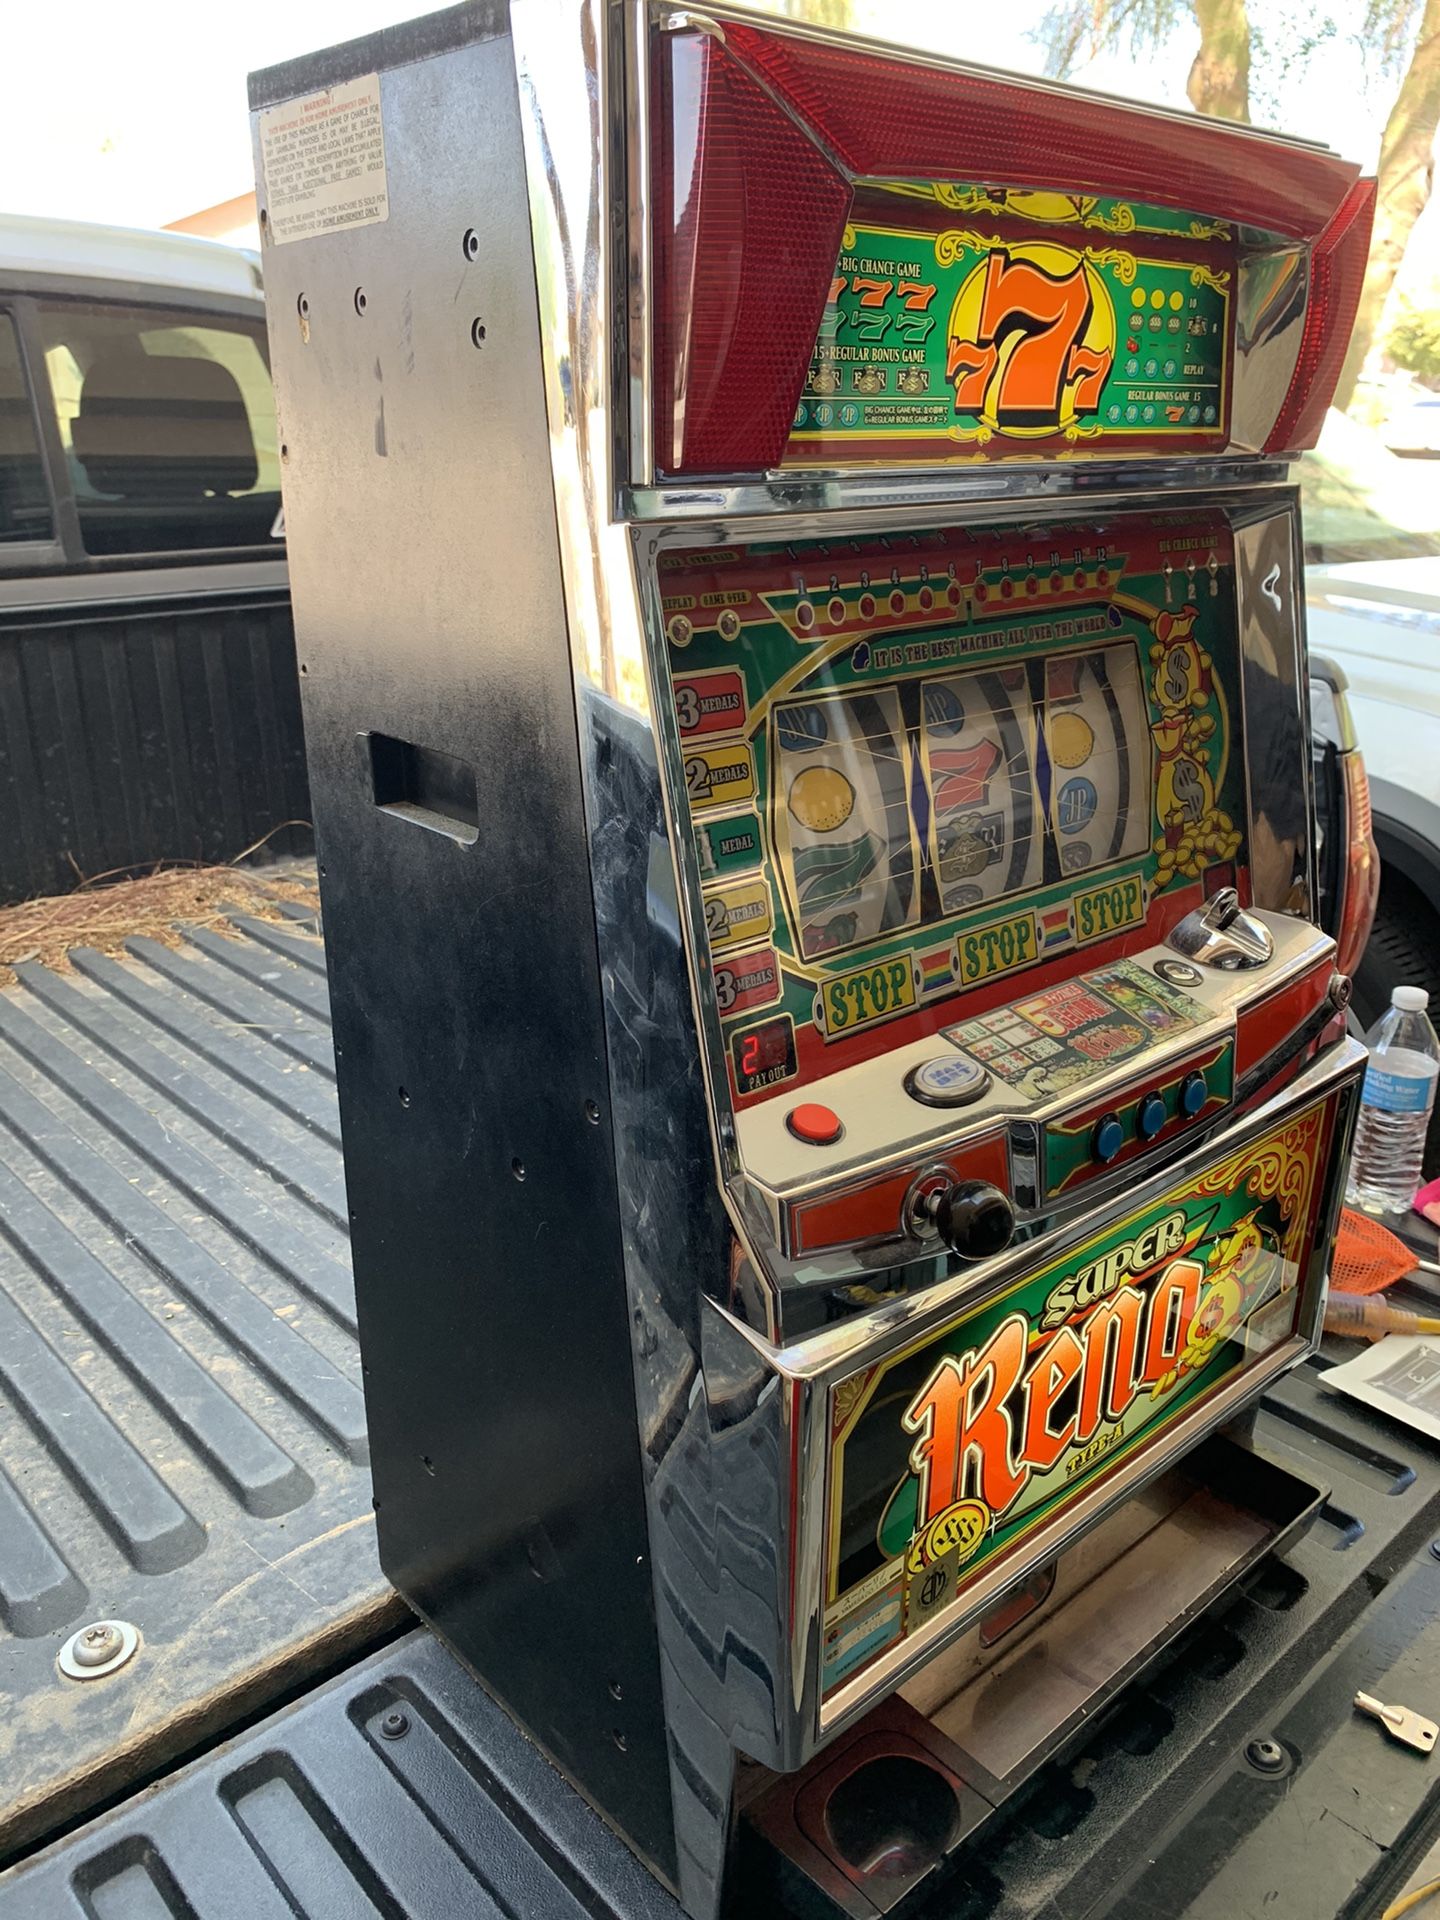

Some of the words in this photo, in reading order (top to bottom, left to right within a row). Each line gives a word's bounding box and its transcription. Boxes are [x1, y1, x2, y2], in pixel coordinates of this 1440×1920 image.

[288, 129, 298, 140] THIS
[299, 123, 317, 136] MACHINE
[330, 115, 342, 127] GAME
[350, 107, 368, 120] CHANCE
[369, 103, 378, 114] FOR
[303, 95, 330, 112] WARNING
[315, 109, 327, 121] HOME
[328, 99, 356, 116] AMUSEMENT
[304, 145, 317, 156] STATE
[318, 142, 326, 152] AND
[341, 134, 354, 145] LAWS
[355, 131, 366, 142] THAT
[860, 259, 895, 275] CHANCE
[897, 263, 921, 277] GAME
[979, 249, 1093, 412] 7
[1185, 343, 1191, 353] 2
[871, 348, 900, 363] BONUS
[902, 350, 926, 364] GAME
[1184, 364, 1204, 376] REPLAY
[874, 406, 896, 414] CHANCE
[1128, 390, 1154, 402] REGULAR
[1155, 391, 1174, 402] BONUS
[1175, 391, 1190, 402] GAME
[1173, 538, 1199, 551] CHANCE
[799, 578, 806, 595] 1
[830, 574, 838, 592] 2
[860, 571, 869, 589] 3
[891, 568, 899, 586] 4
[920, 565, 929, 582] 5
[948, 562, 956, 578] 6
[976, 560, 983, 576] 7
[1002, 557, 1009, 573] 8
[1026, 554, 1034, 570] 9
[1050, 551, 1061, 568] 10
[1073, 549, 1083, 565] 11
[1096, 547, 1107, 563] 12
[703, 594, 725, 607] GAME
[727, 592, 748, 604] OVER
[1165, 585, 1173, 603] 1
[1188, 583, 1197, 600] 2
[875, 652, 889, 668] IT
[891, 650, 902, 666] IS
[906, 645, 928, 663] THE
[930, 640, 957, 659] BEST
[959, 631, 1005, 652] MACHINE
[1007, 628, 1026, 645] ALL
[1029, 625, 1053, 642] OVER
[1054, 621, 1073, 638] THE
[1076, 617, 1107, 635] WORLD
[676, 687, 700, 728] 3
[700, 694, 740, 713] MEDALS
[686, 758, 712, 801] 2
[709, 763, 749, 785] MEDALS
[1066, 788, 1087, 820] JP
[696, 833, 716, 870] 1
[720, 834, 754, 855] MEDAL
[706, 899, 731, 940] 2
[726, 901, 765, 925] MEDALS
[1080, 882, 1138, 944] STOP
[963, 919, 1031, 979] STOP
[717, 970, 736, 1008] 3
[735, 968, 773, 992] MEDALS
[829, 961, 907, 1027] STOP
[743, 1036, 758, 1074] 2
[1041, 1210, 1188, 1331] SUPER
[903, 1259, 1205, 1522] Reno
[1066, 1422, 1124, 1475] TYPE-A
